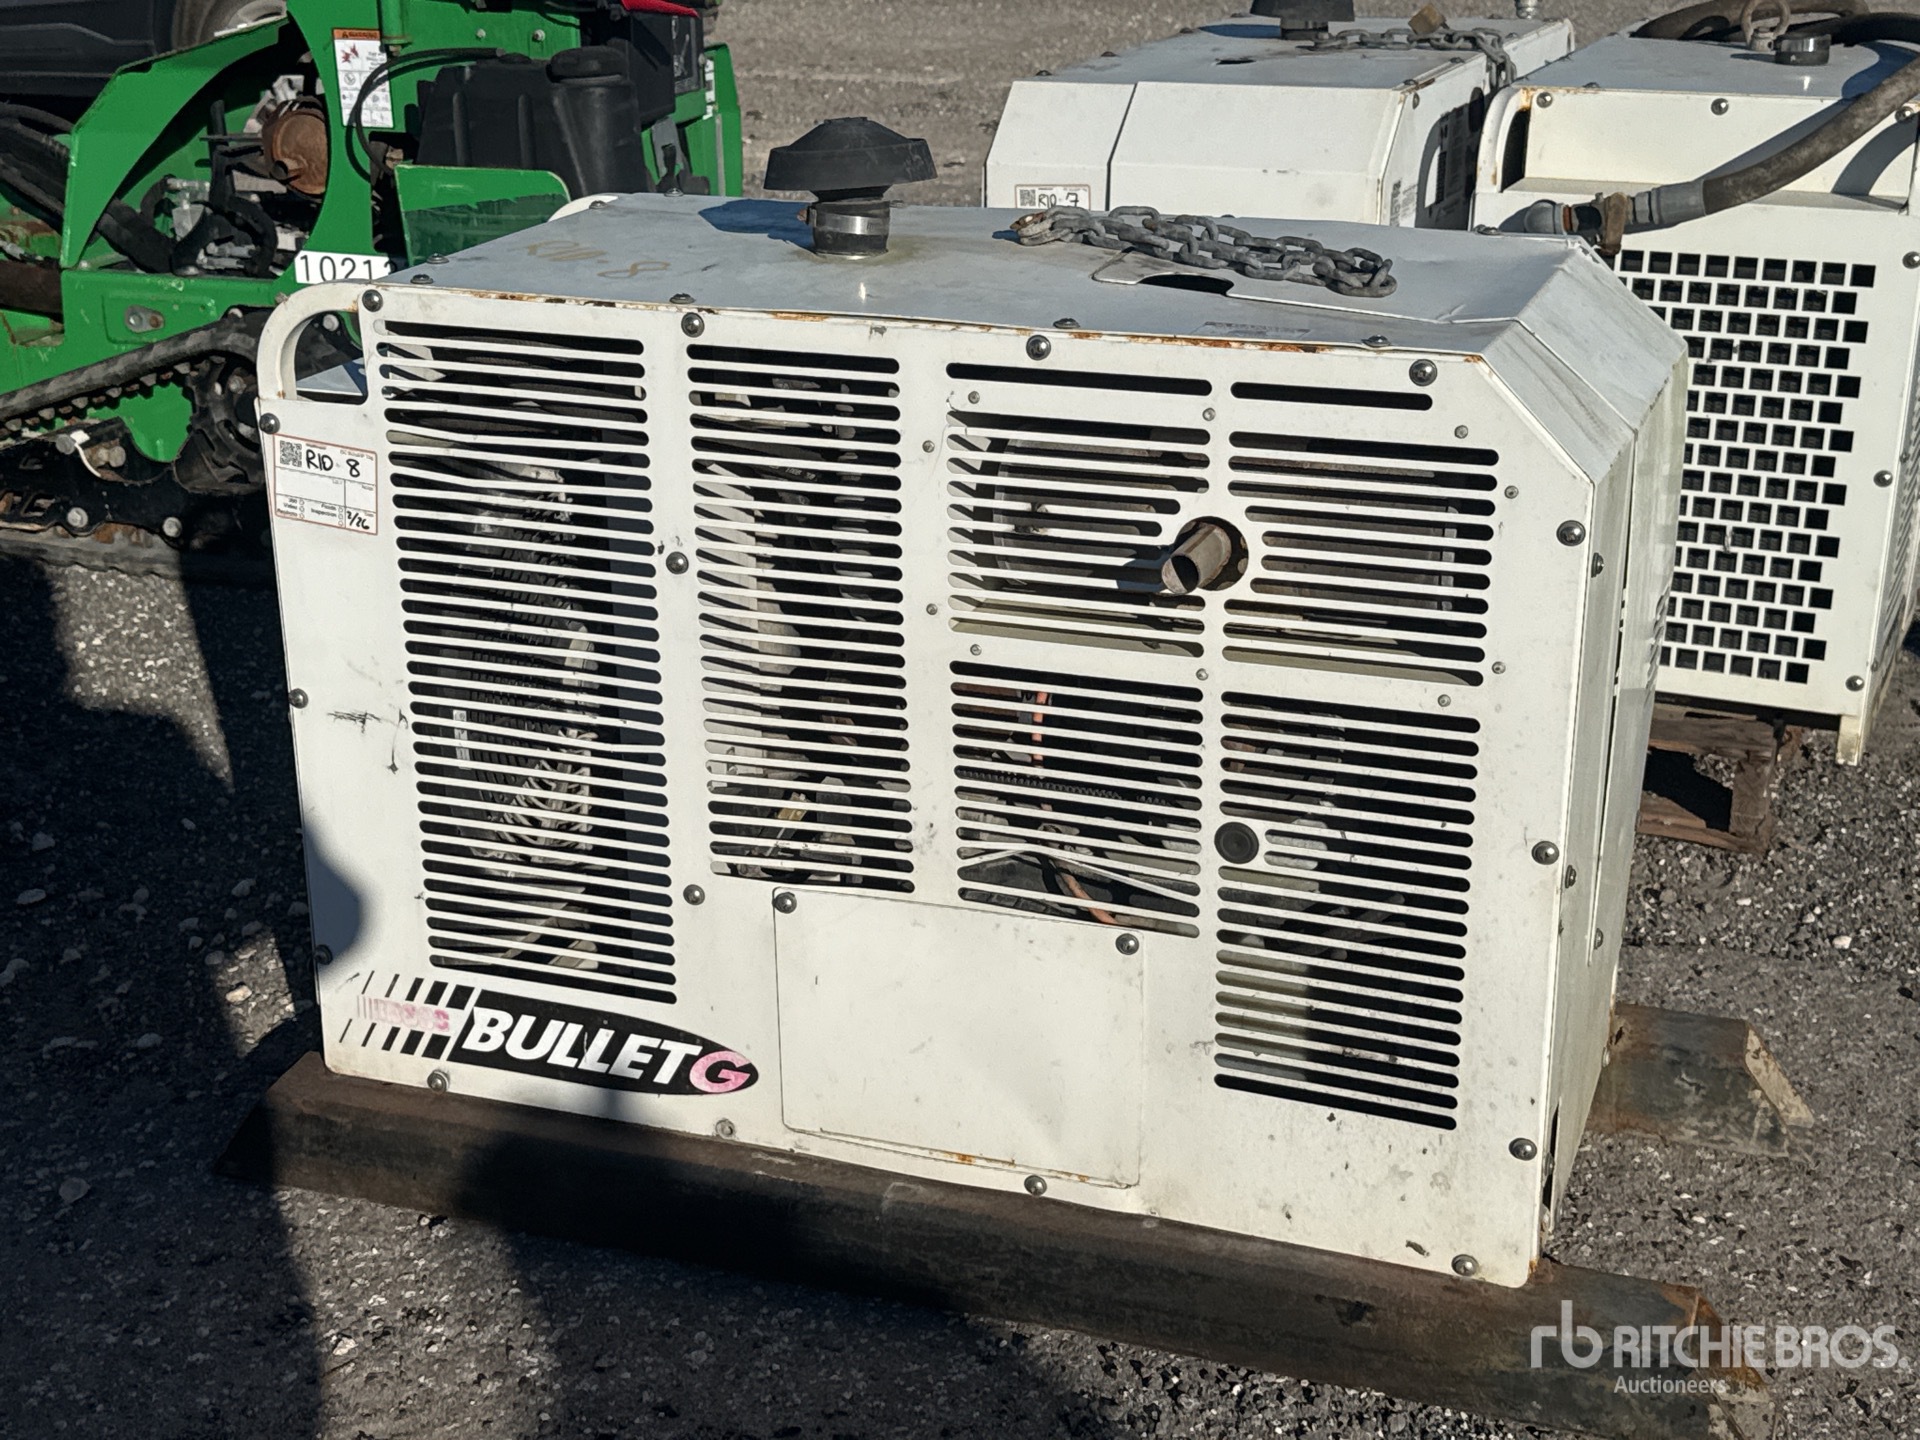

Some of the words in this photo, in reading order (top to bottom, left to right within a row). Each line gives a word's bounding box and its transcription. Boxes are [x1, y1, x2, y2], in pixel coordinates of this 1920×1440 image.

[1065, 192, 1079, 207] 7
[346, 458, 361, 478] 8
[461, 1006, 702, 1085] BULLET
[689, 1050, 751, 1093] G
